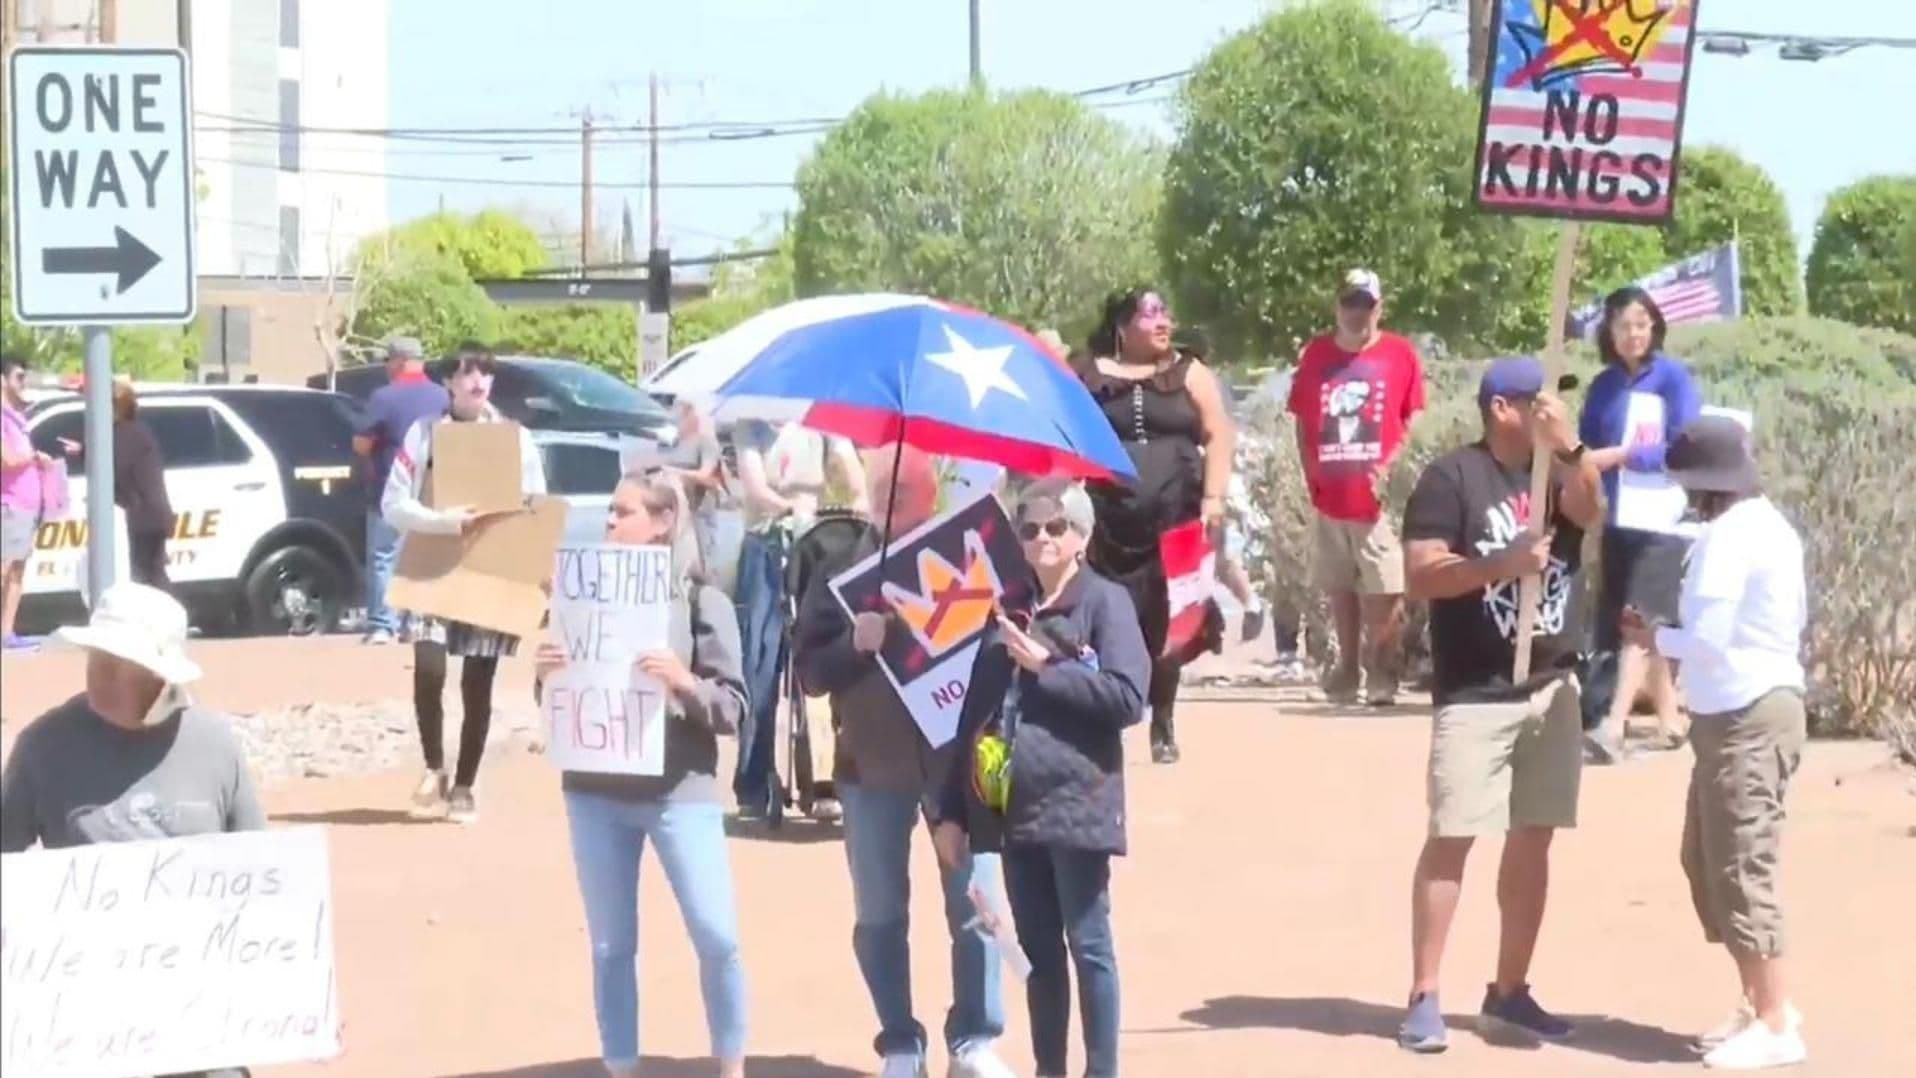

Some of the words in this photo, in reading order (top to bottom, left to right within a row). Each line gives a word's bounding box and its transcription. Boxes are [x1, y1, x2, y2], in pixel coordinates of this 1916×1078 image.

[36, 73, 165, 133] ONE
[1543, 89, 1619, 145] NO
[35, 149, 170, 209] WAY
[1484, 141, 1663, 207] KINGS
[556, 548, 669, 605] TOGETHER
[560, 610, 624, 662] WE
[551, 688, 656, 760] FIGHT
[931, 680, 965, 710] NO
[53, 854, 120, 913] No
[143, 847, 285, 910] Kings
[201, 899, 326, 965] More!
